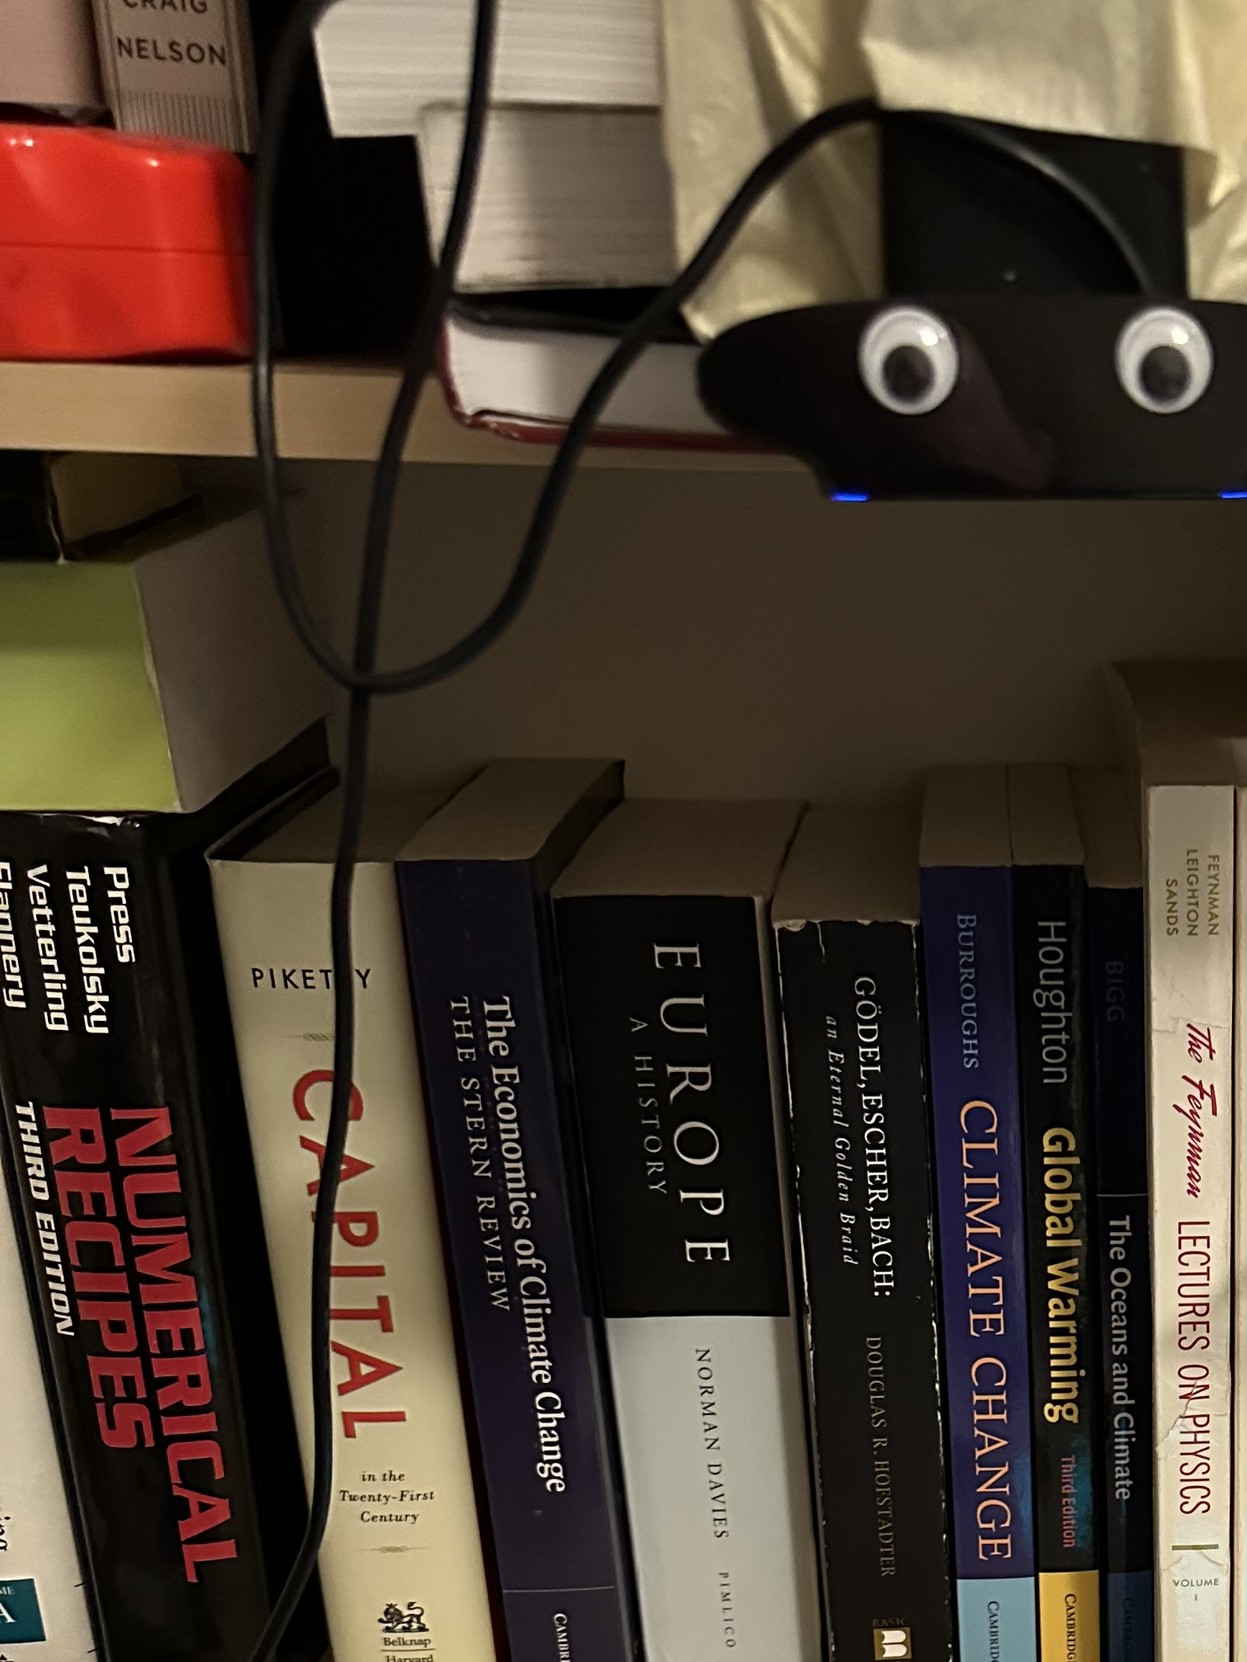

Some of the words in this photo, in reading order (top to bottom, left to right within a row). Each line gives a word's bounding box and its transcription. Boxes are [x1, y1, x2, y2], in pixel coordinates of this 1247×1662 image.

[116, 36, 227, 68] NELSON
[104, 866, 135, 963] Press
[1166, 879, 1178, 936] SANDS
[1186, 849, 1198, 937] LEIGHTON
[1208, 854, 1220, 936] FEYNMAN
[27, 864, 69, 1031] Vetterling
[66, 865, 109, 1034] Teukolsky
[252, 967, 370, 990] PIKETY
[957, 913, 979, 1069] BURROUGHS
[450, 996, 476, 1062] THE
[483, 995, 515, 1057] The
[630, 1016, 649, 1032] A
[825, 1015, 838, 1039] an
[854, 976, 883, 1088] GÖDEL,
[1033, 920, 1073, 1085] Houghton
[1186, 1023, 1215, 1063] The
[461, 1077, 492, 1178] STERN
[634, 1055, 667, 1195] HISTORY
[654, 941, 731, 1264] EUROPE
[828, 1049, 848, 1127] Eternal
[491, 1065, 537, 1231] Economics
[833, 1136, 851, 1203] Golden
[862, 1092, 890, 1212] ESCHER,
[1172, 1074, 1217, 1198] Feynman
[15, 1101, 49, 1200] THIRD
[35, 1211, 75, 1337] EDITION
[959, 1100, 1006, 1339] CLIMATE
[1043, 1127, 1082, 1248] Global
[43, 1105, 155, 1449] RECIPES
[292, 1069, 407, 1439] CAPITAL
[475, 1195, 510, 1311] REVIEW
[514, 1238, 546, 1273] of
[839, 1212, 859, 1265] Braid
[869, 1215, 895, 1297] BACH:
[1109, 1215, 1130, 1262] The
[520, 1275, 553, 1385] Climate
[1110, 1267, 1132, 1357] Oceans
[1177, 1221, 1211, 1351] LECTURES
[110, 1106, 237, 1583] NUMERICAL
[1043, 1261, 1086, 1424] Warming
[1111, 1362, 1131, 1405] and
[1177, 1365, 1211, 1400] ON
[534, 1391, 566, 1493] Change
[695, 1348, 721, 1451] NORMAN
[339, 1489, 435, 1504] Twenty-First
[361, 1470, 376, 1482] in
[382, 1470, 405, 1482] the
[707, 1462, 730, 1539] DAVIES
[970, 1357, 1012, 1561] CHANGE
[1113, 1411, 1131, 1501] Climate
[1179, 1414, 1211, 1515] PHYSICS
[360, 1510, 419, 1524] Century
[382, 1637, 431, 1651] Belknap
[718, 1571, 736, 1649] PIMLICO
